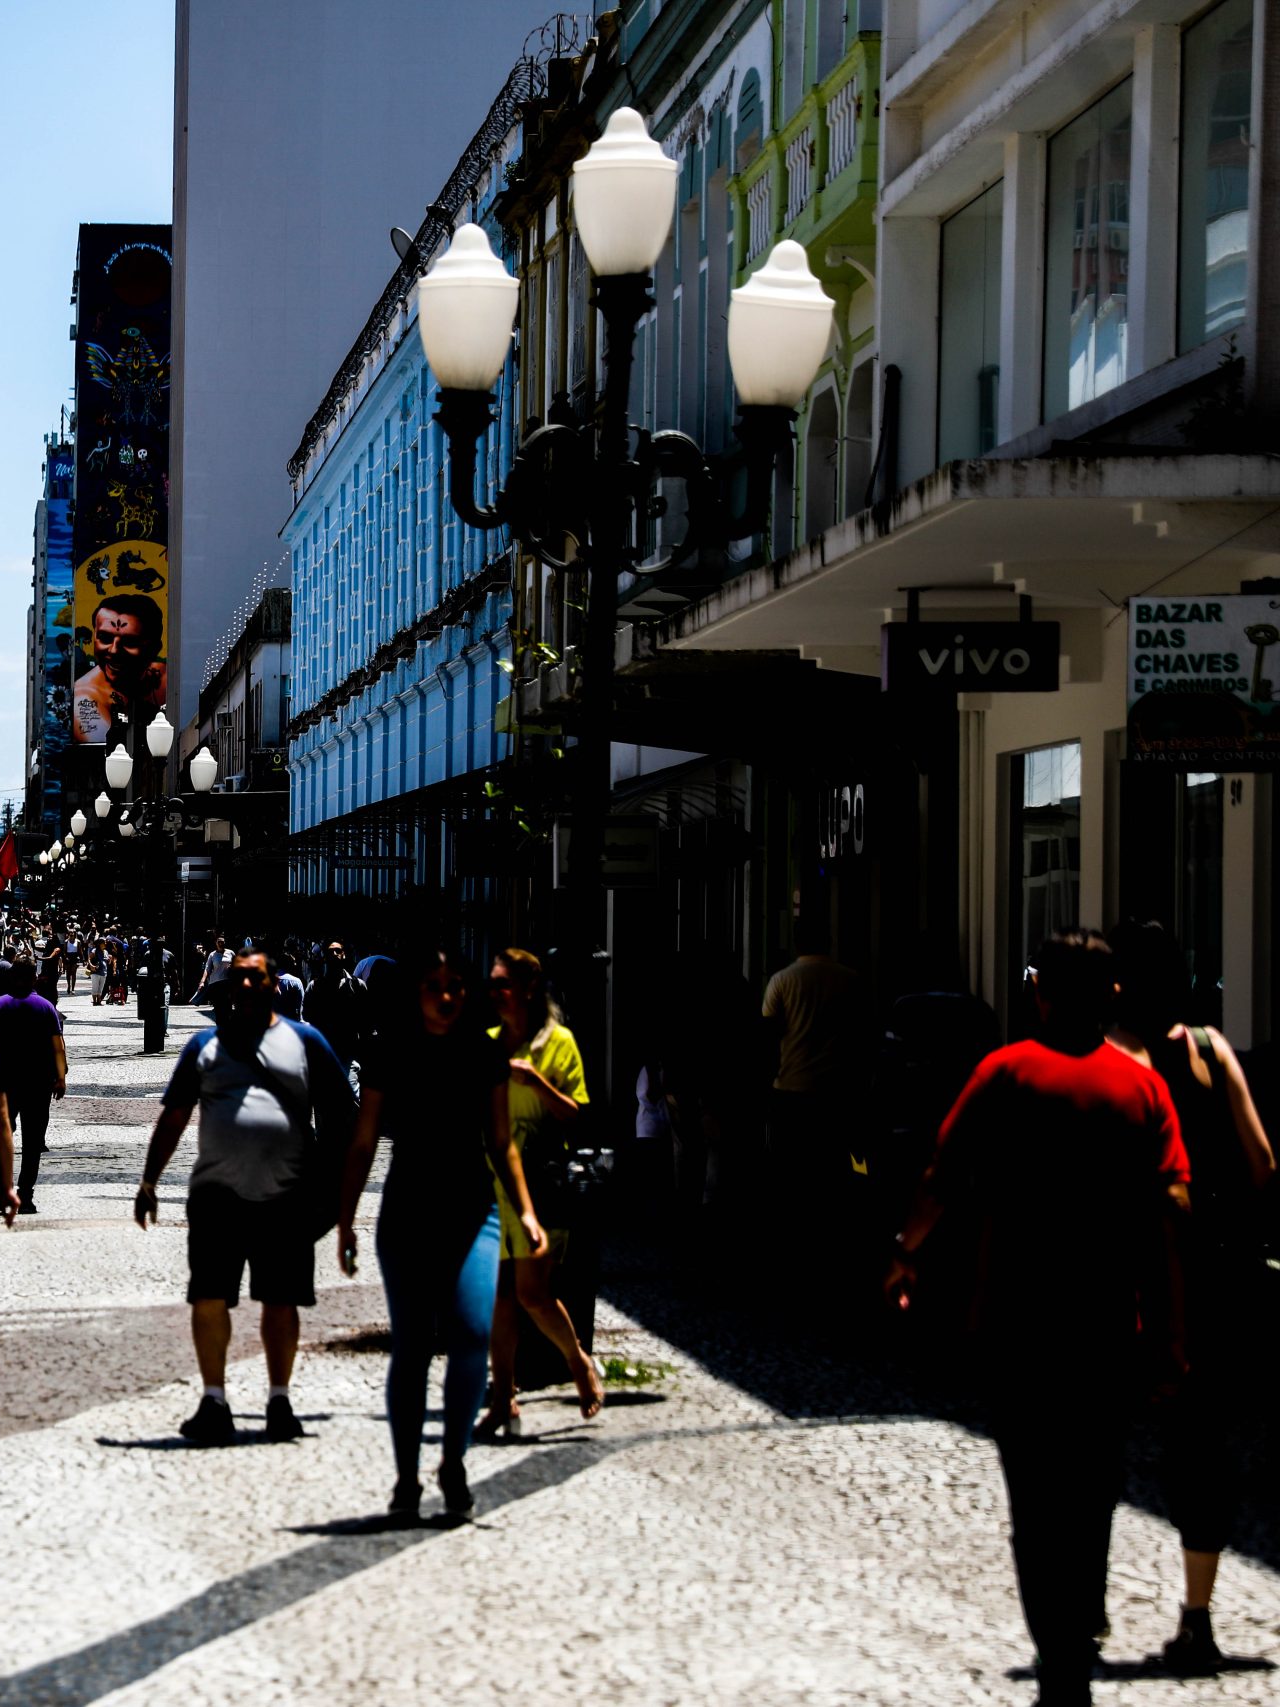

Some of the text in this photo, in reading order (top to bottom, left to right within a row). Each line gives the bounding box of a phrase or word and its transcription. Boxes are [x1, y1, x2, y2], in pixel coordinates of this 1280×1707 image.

[1136, 603, 1222, 623] BAZAR
[1136, 629, 1186, 648] DAS
[918, 634, 1031, 676] vivo
[1135, 654, 1239, 673] CHAVES
[1135, 678, 1248, 693] E CARIMBOS
[818, 783, 864, 859] LUPO
